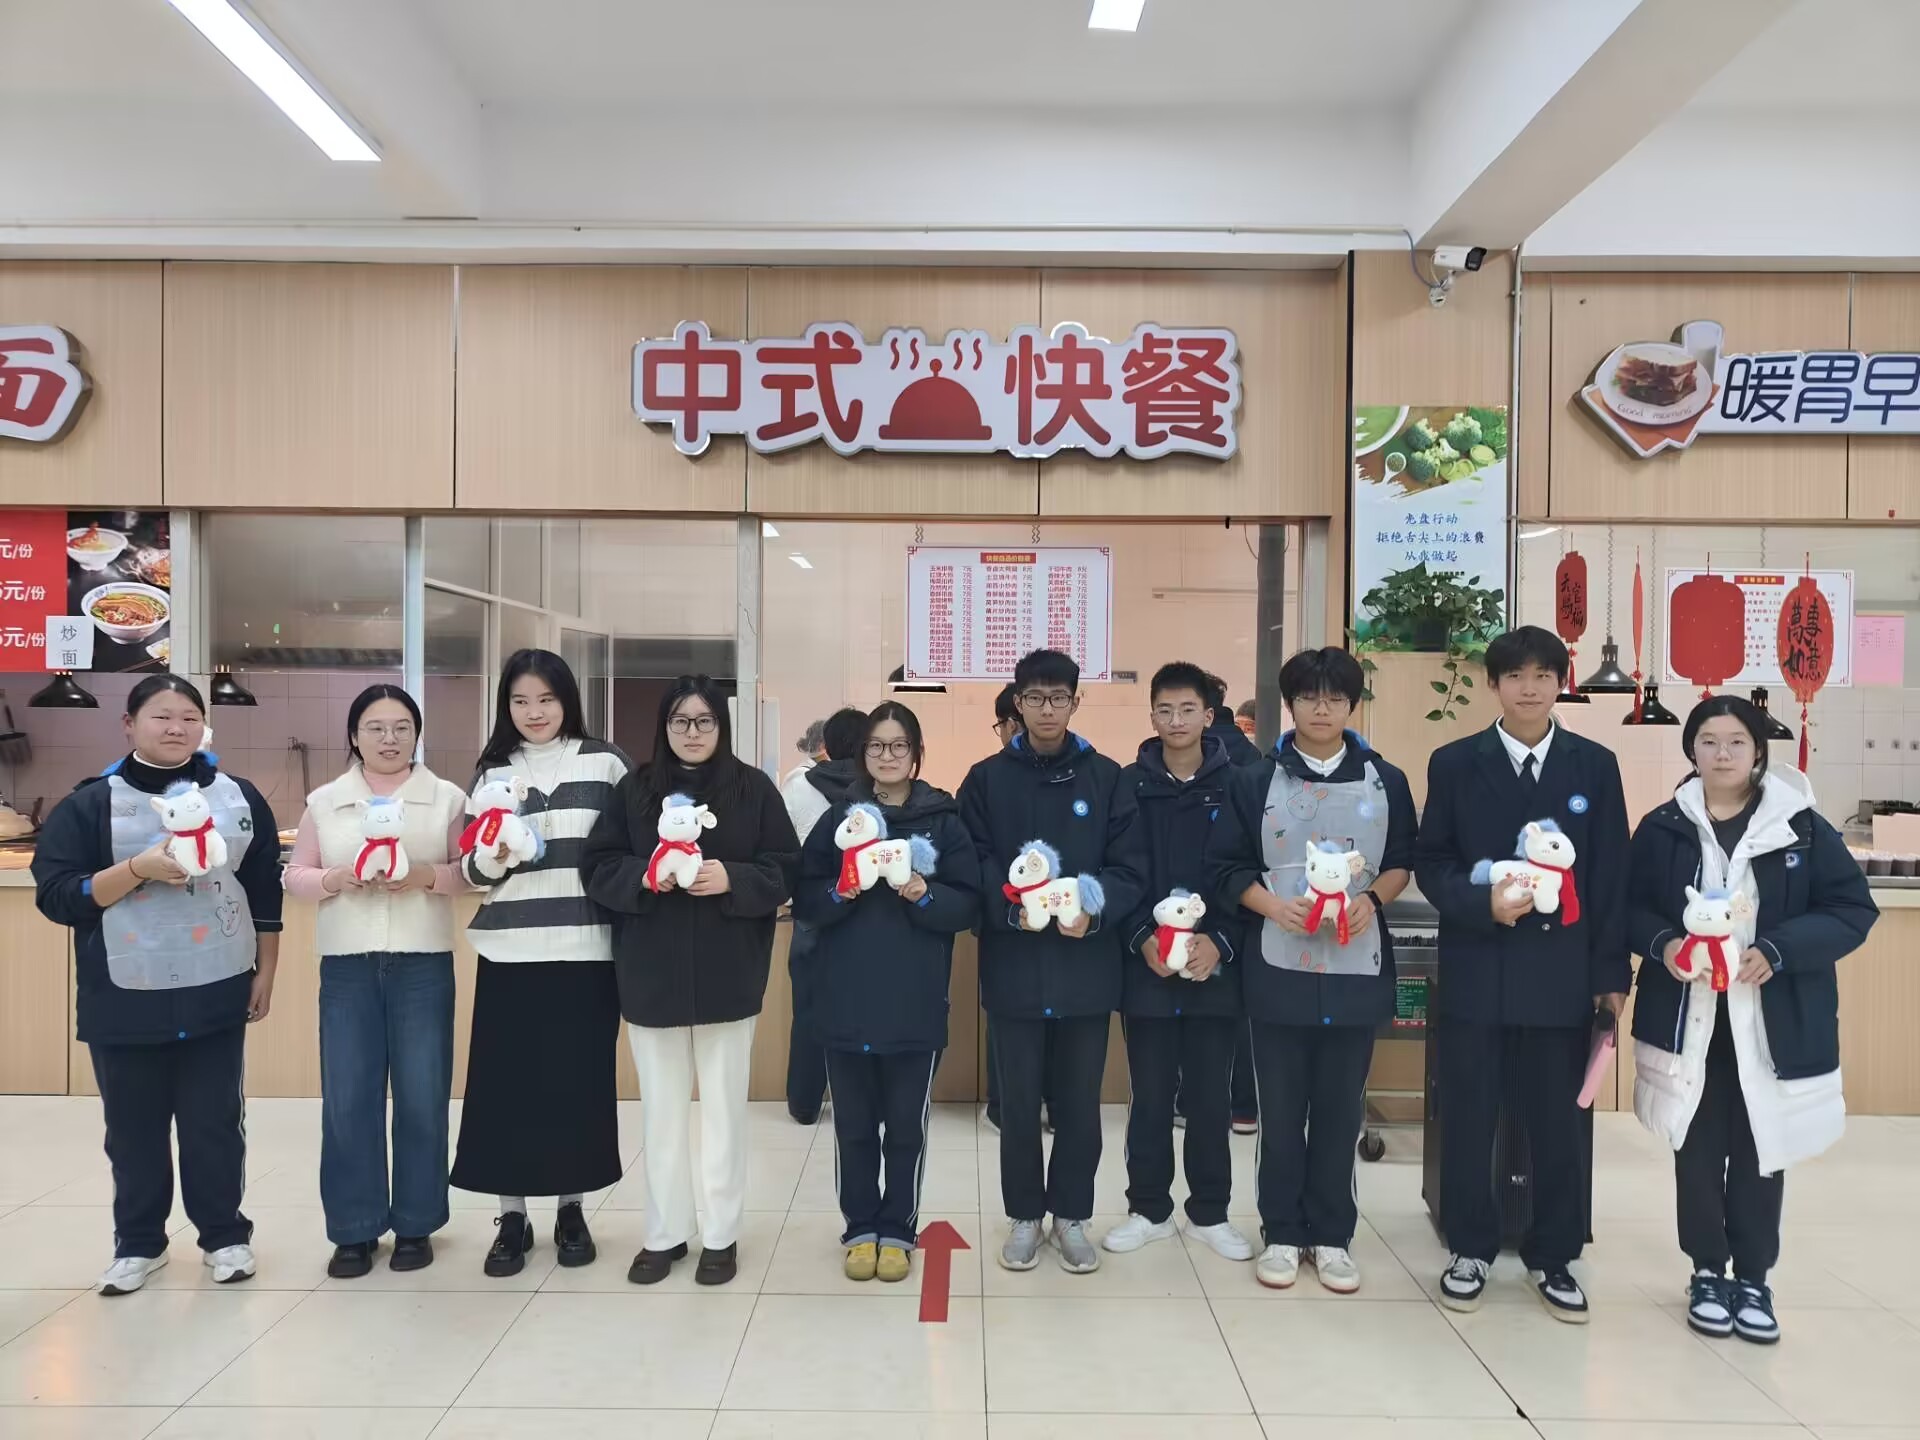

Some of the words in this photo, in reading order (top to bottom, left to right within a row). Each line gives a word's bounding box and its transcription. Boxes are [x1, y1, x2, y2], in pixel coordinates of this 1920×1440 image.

[0, 337, 67, 427] 面
[642, 330, 864, 443] 中式
[1004, 331, 1231, 448] 快餐
[1720, 354, 1920, 425] 暖胃早
[1404, 512, 1458, 525] 光盘行动
[1404, 550, 1458, 562] 从我做起
[0, 580, 46, 601] 元/份
[0, 627, 46, 648] 元/份
[60, 624, 78, 666] 炒面
